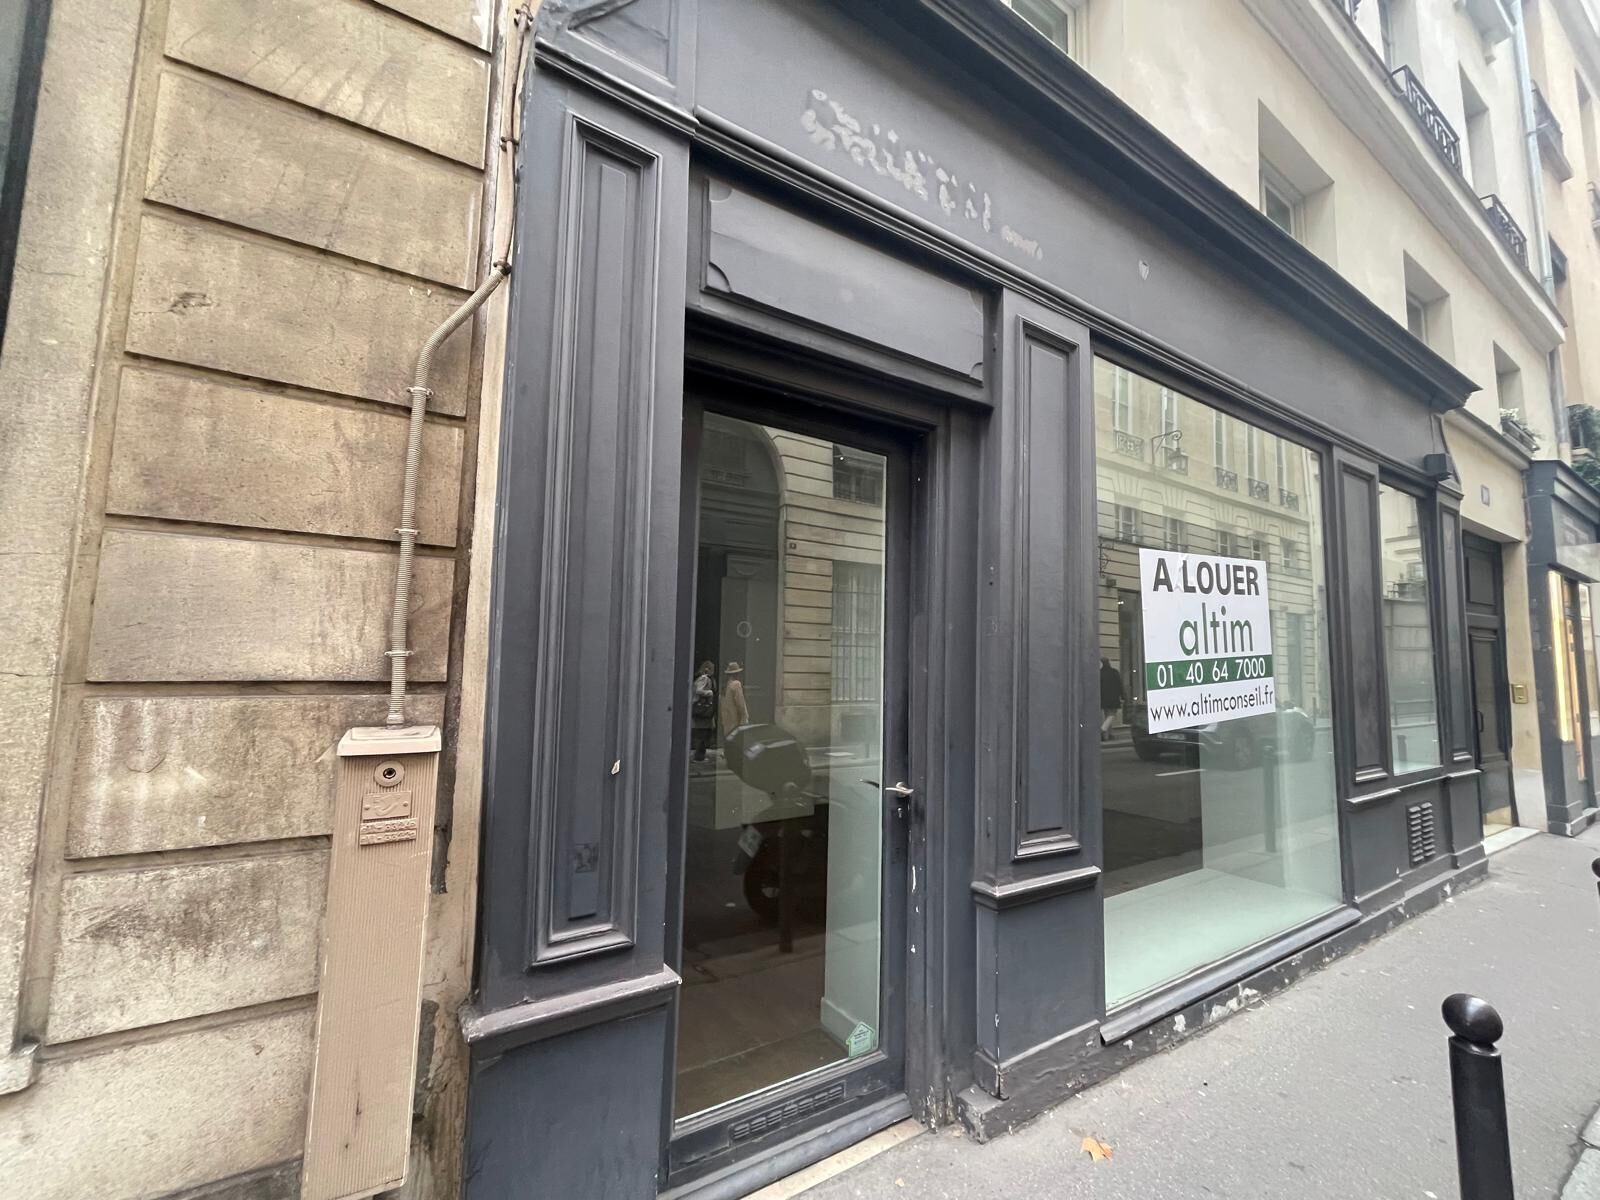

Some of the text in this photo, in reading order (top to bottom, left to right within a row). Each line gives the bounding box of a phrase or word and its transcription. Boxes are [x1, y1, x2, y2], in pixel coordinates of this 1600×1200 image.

[1153, 558, 1259, 595] A LOUER
[1179, 602, 1253, 656] altim
[1157, 657, 1266, 687] 01 40 64 7000
[1150, 685, 1273, 721] www.altimconseil.fr
